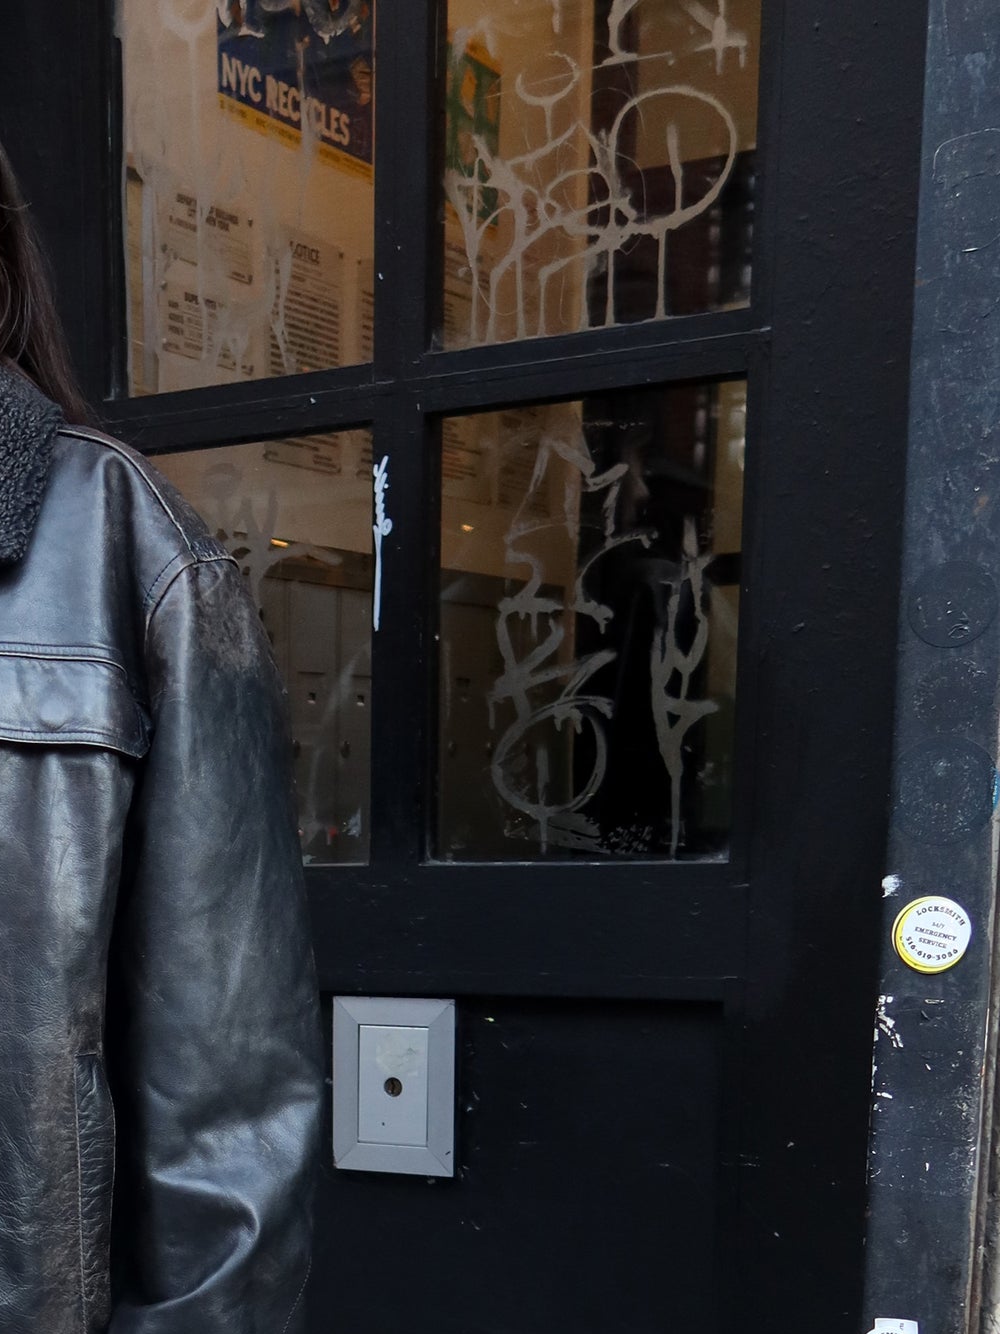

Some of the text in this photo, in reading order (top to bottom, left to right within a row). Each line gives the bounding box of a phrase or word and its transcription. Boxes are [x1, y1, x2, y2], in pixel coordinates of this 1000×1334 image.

[222, 52, 262, 102] NYC
[266, 75, 350, 146] RECCLES
[915, 906, 966, 926] LOCKSMITH
[914, 926, 957, 941] EMERGENCY
[918, 937, 947, 949] SERVICE
